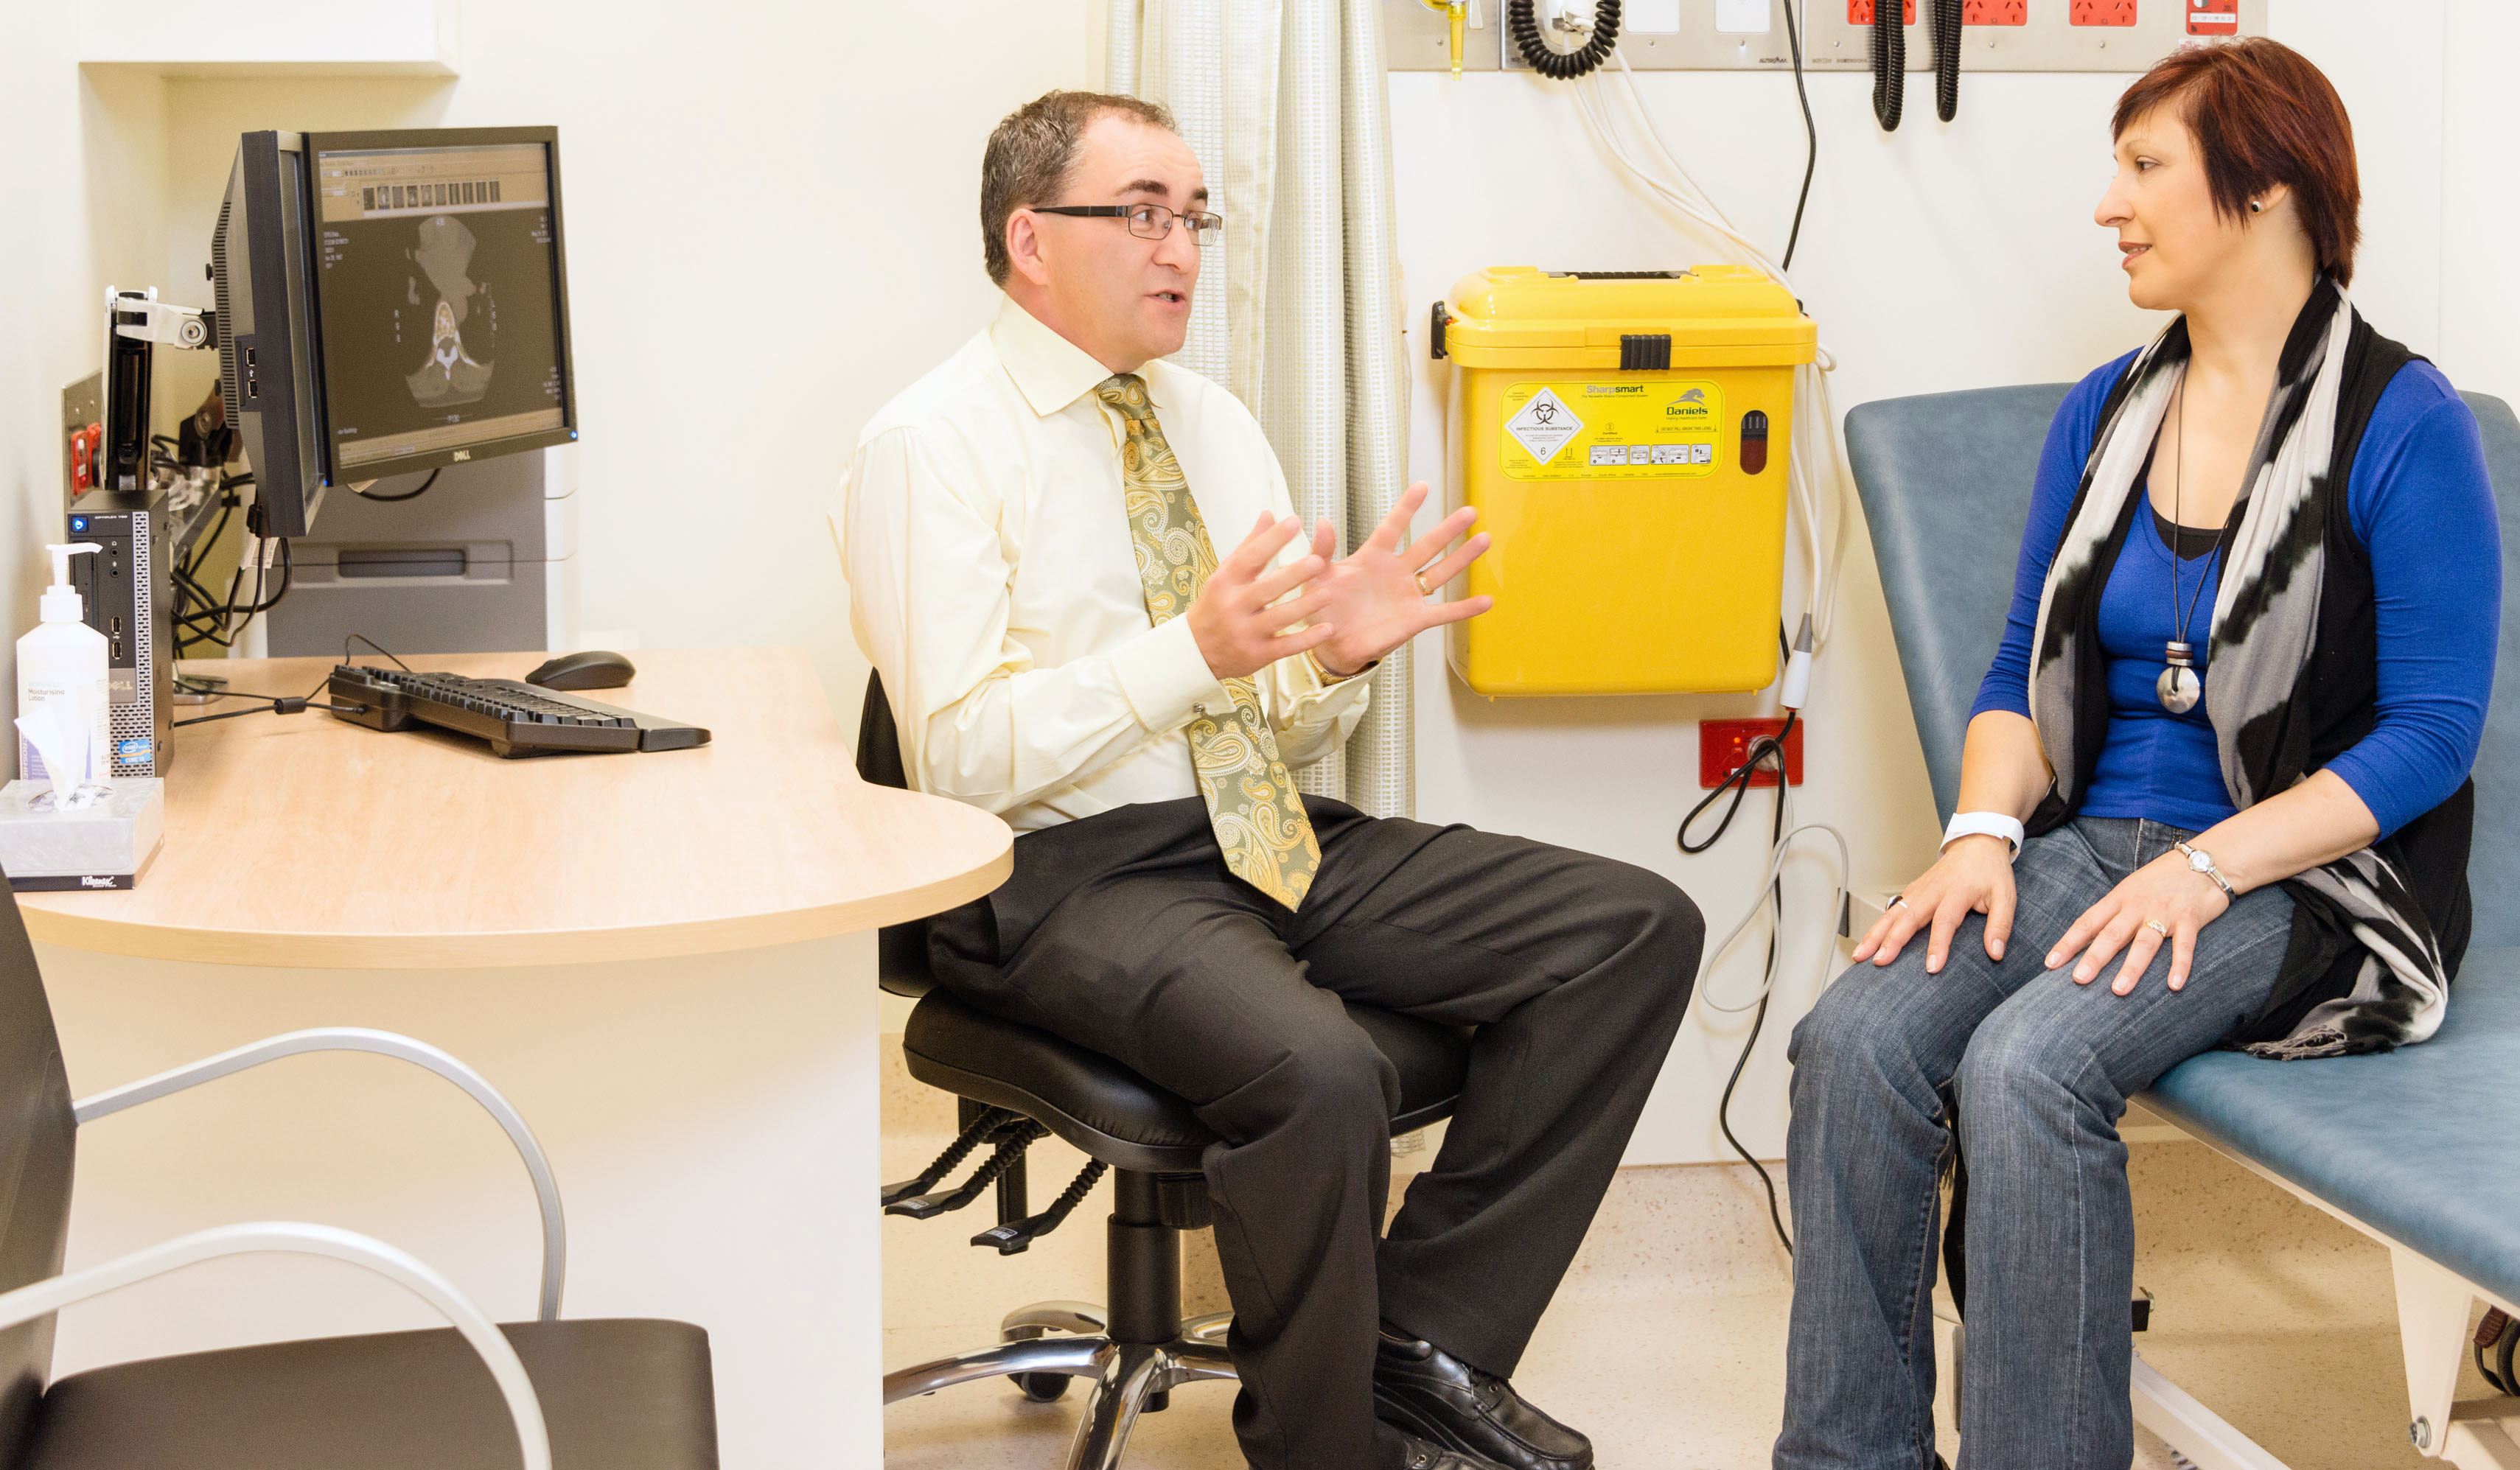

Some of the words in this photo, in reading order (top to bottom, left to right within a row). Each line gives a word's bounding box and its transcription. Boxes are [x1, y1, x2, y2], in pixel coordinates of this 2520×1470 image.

[1586, 385, 1644, 395] Sharpsmart
[1666, 406, 1708, 416] Daniels
[454, 449, 471, 462] DELL
[1540, 447, 1546, 455] 6
